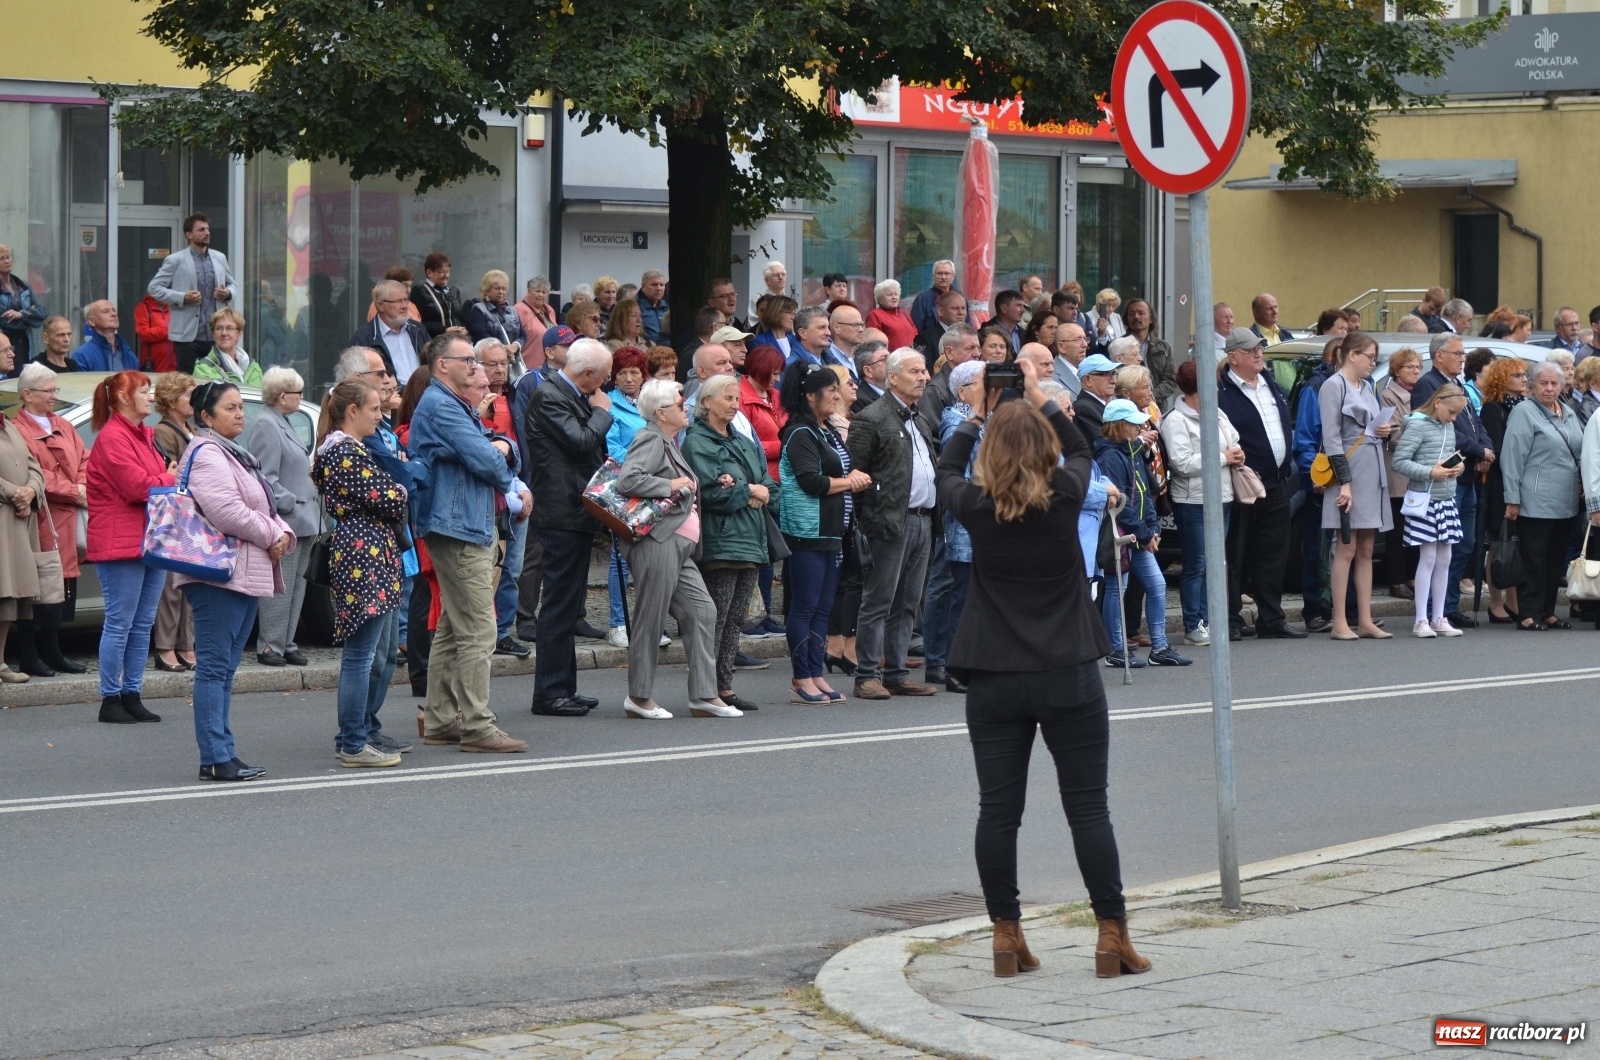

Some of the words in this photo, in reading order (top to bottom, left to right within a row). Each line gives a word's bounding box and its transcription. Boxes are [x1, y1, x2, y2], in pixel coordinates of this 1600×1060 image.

[1514, 56, 1579, 68] ADWOKATURA
[1528, 69, 1564, 80] POLSKA
[583, 235, 630, 244] MICKIEWICZA
[637, 235, 644, 246] 9
